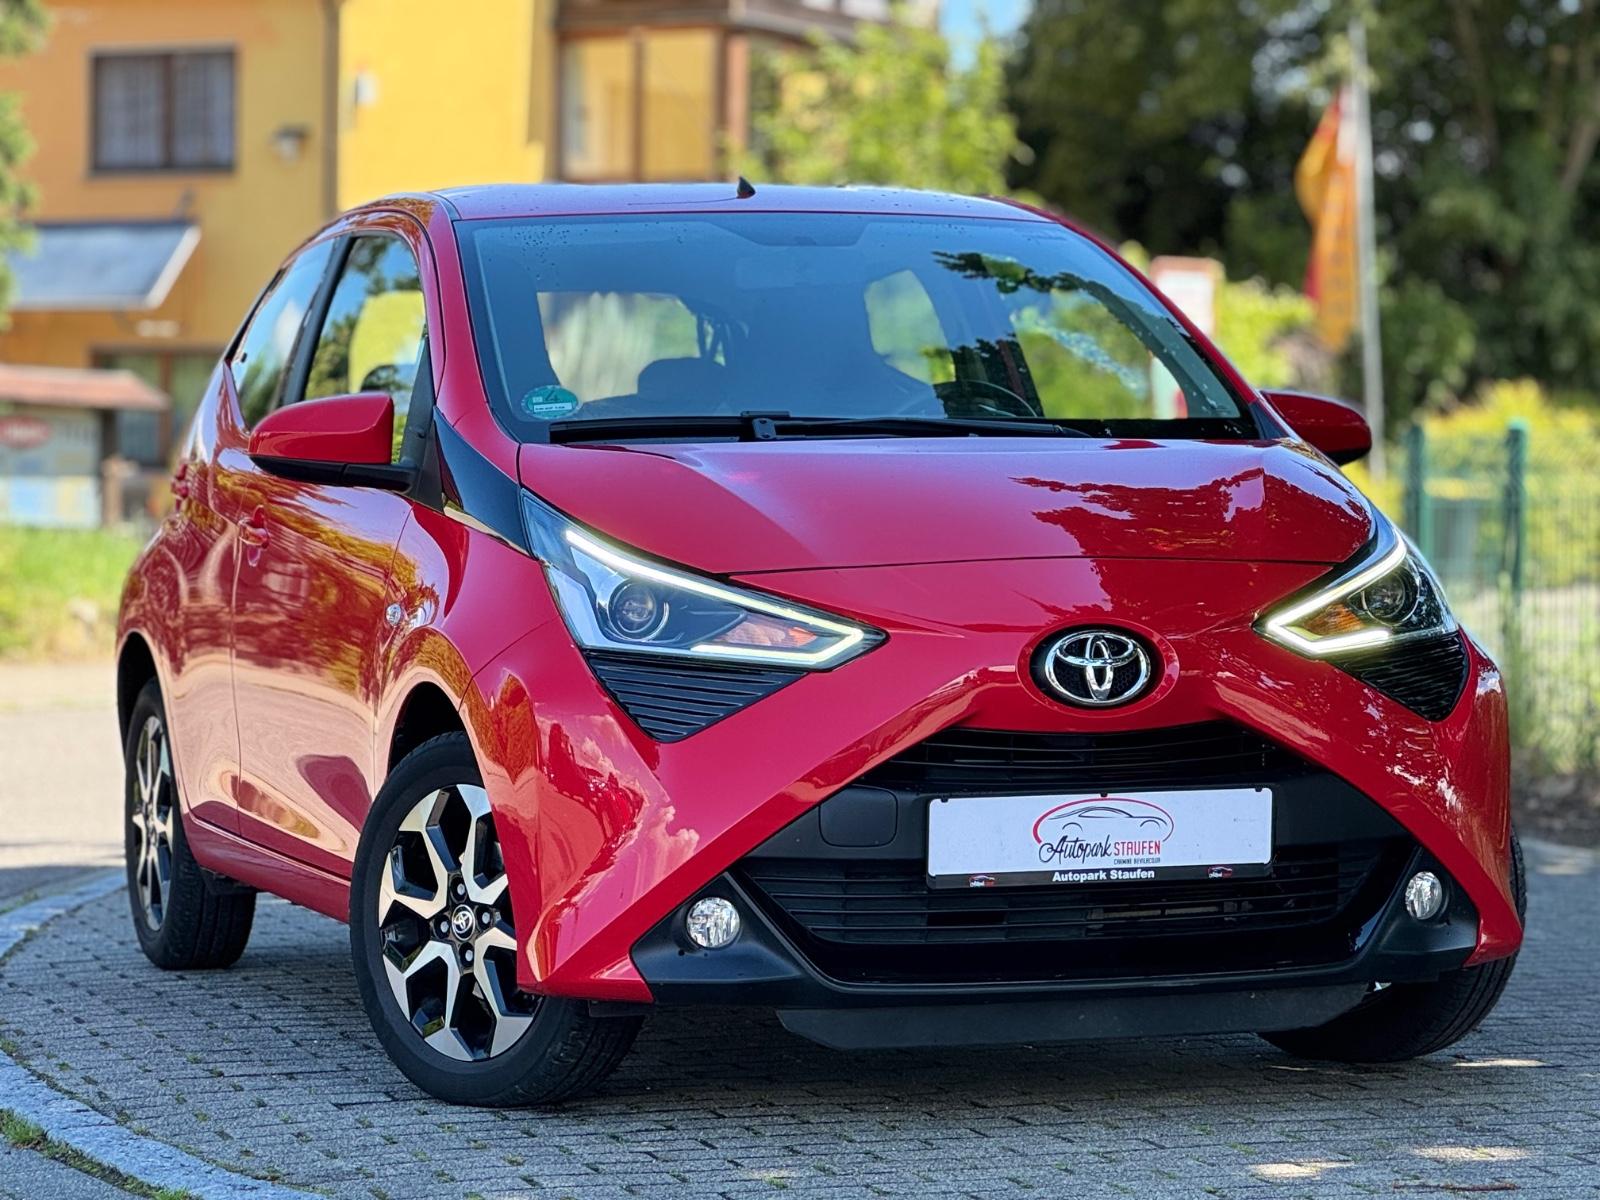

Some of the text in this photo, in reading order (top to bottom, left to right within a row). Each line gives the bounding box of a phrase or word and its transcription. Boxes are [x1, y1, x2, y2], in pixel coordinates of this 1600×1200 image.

[1039, 834, 1161, 864] Autopark STAUFEN
[1052, 868, 1155, 883] Autopark Staufen
